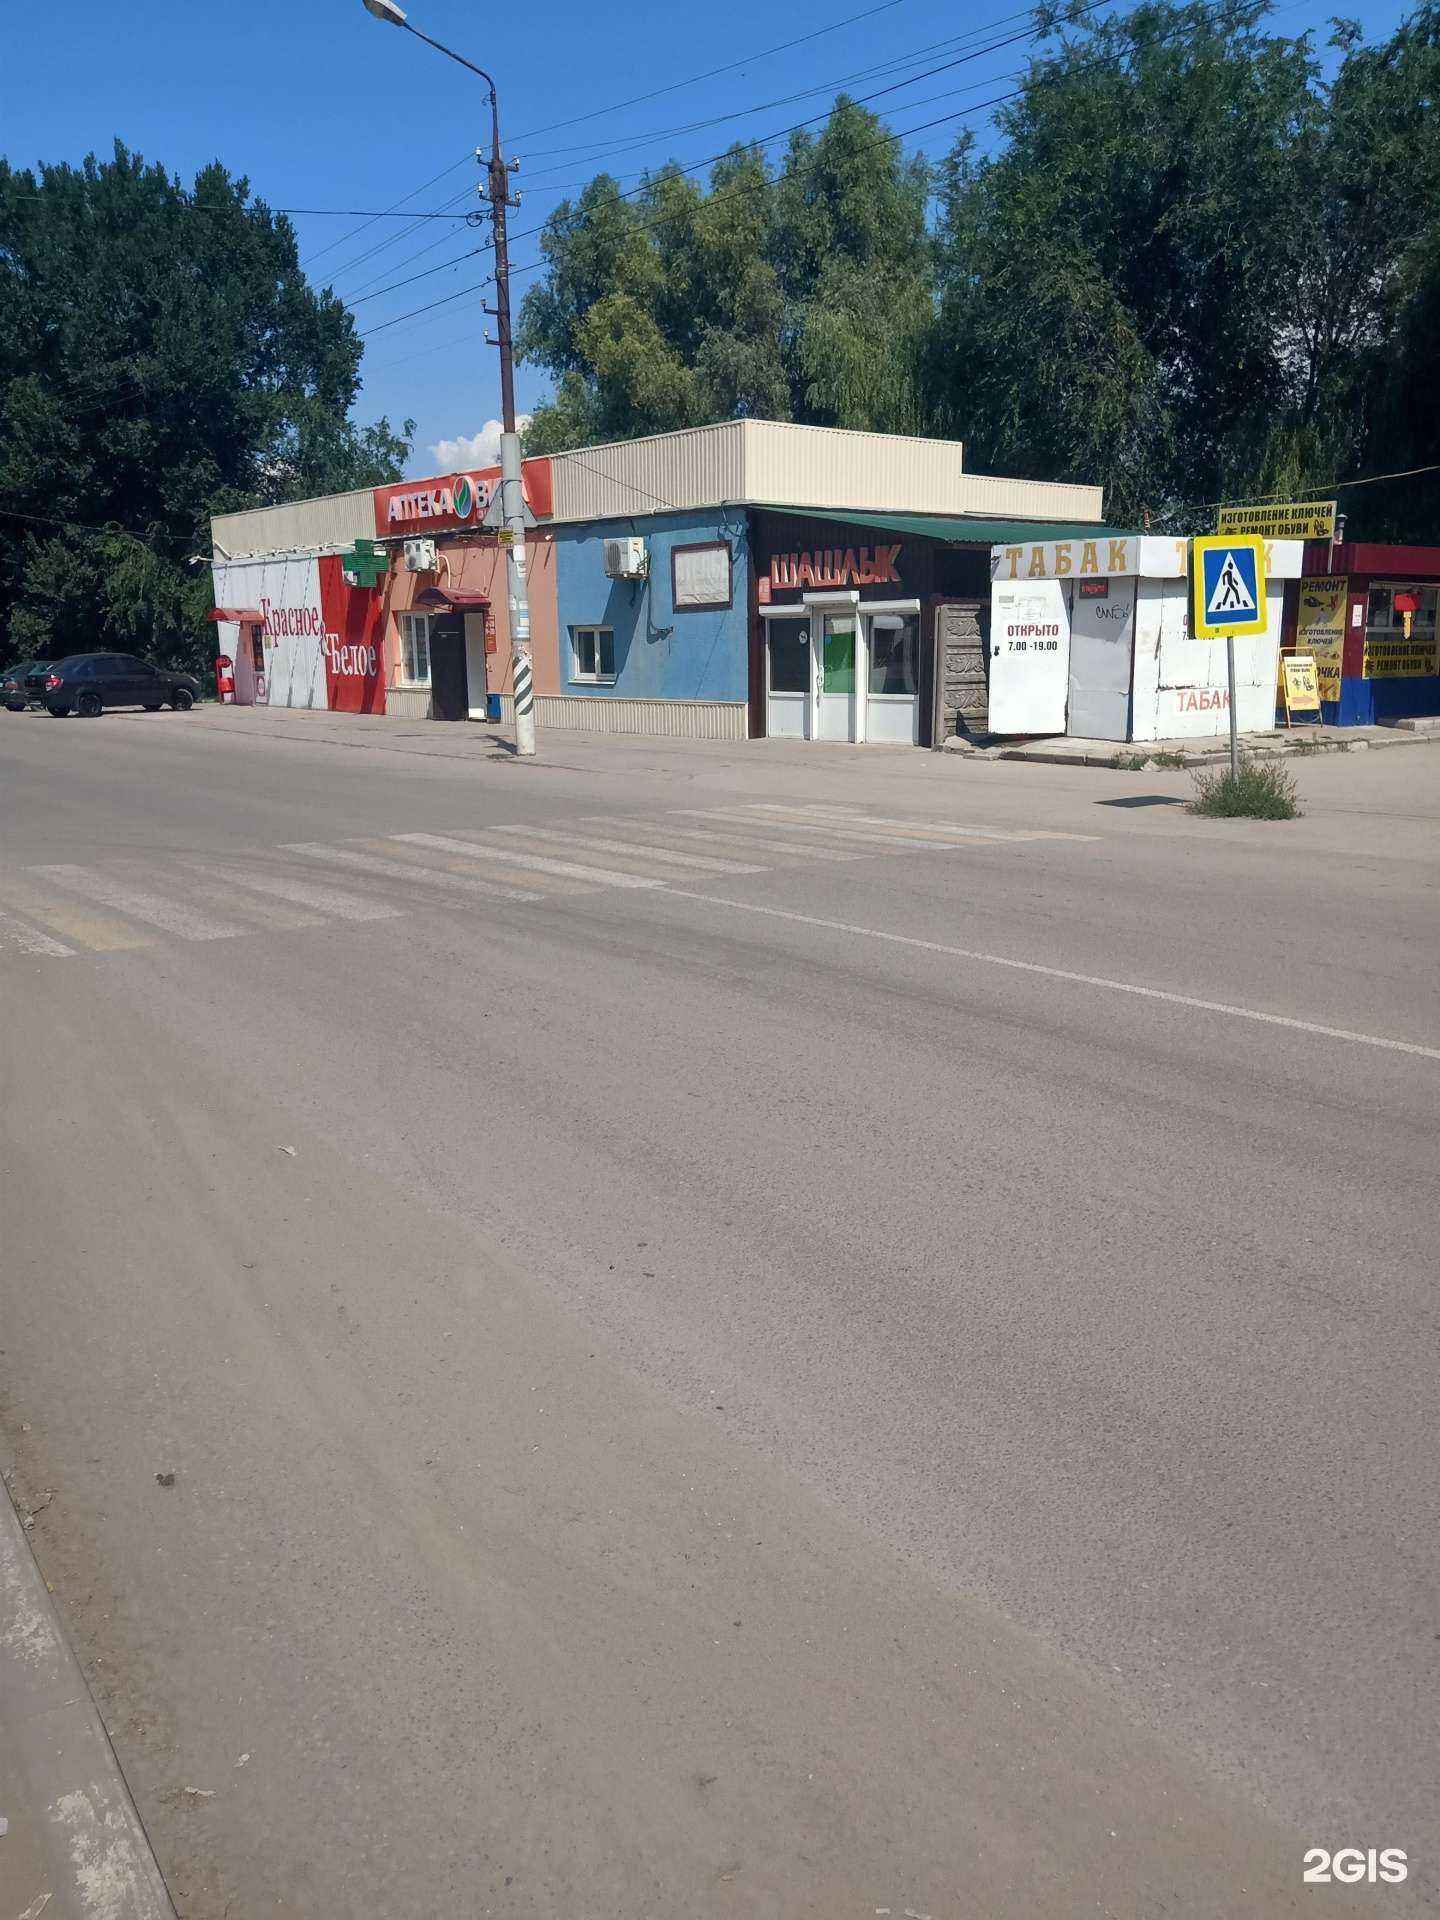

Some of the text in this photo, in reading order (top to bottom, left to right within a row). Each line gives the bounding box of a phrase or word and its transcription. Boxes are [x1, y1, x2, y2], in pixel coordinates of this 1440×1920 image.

[388, 488, 454, 521] АПТЕКА
[1221, 504, 1333, 524] ИЗГОТОВЛЕНИЕ КЛЮЧЕЙ
[1240, 522, 1309, 537] РЕМОНТ ОБУВИ
[771, 544, 902, 589] ШАШЛЫК
[1006, 539, 1129, 579] ТАБАК
[1302, 580, 1346, 593] РЕМОНТ
[261, 598, 320, 647] Красное
[1007, 624, 1059, 637] ОТКРЫТО
[329, 633, 377, 677] Белое
